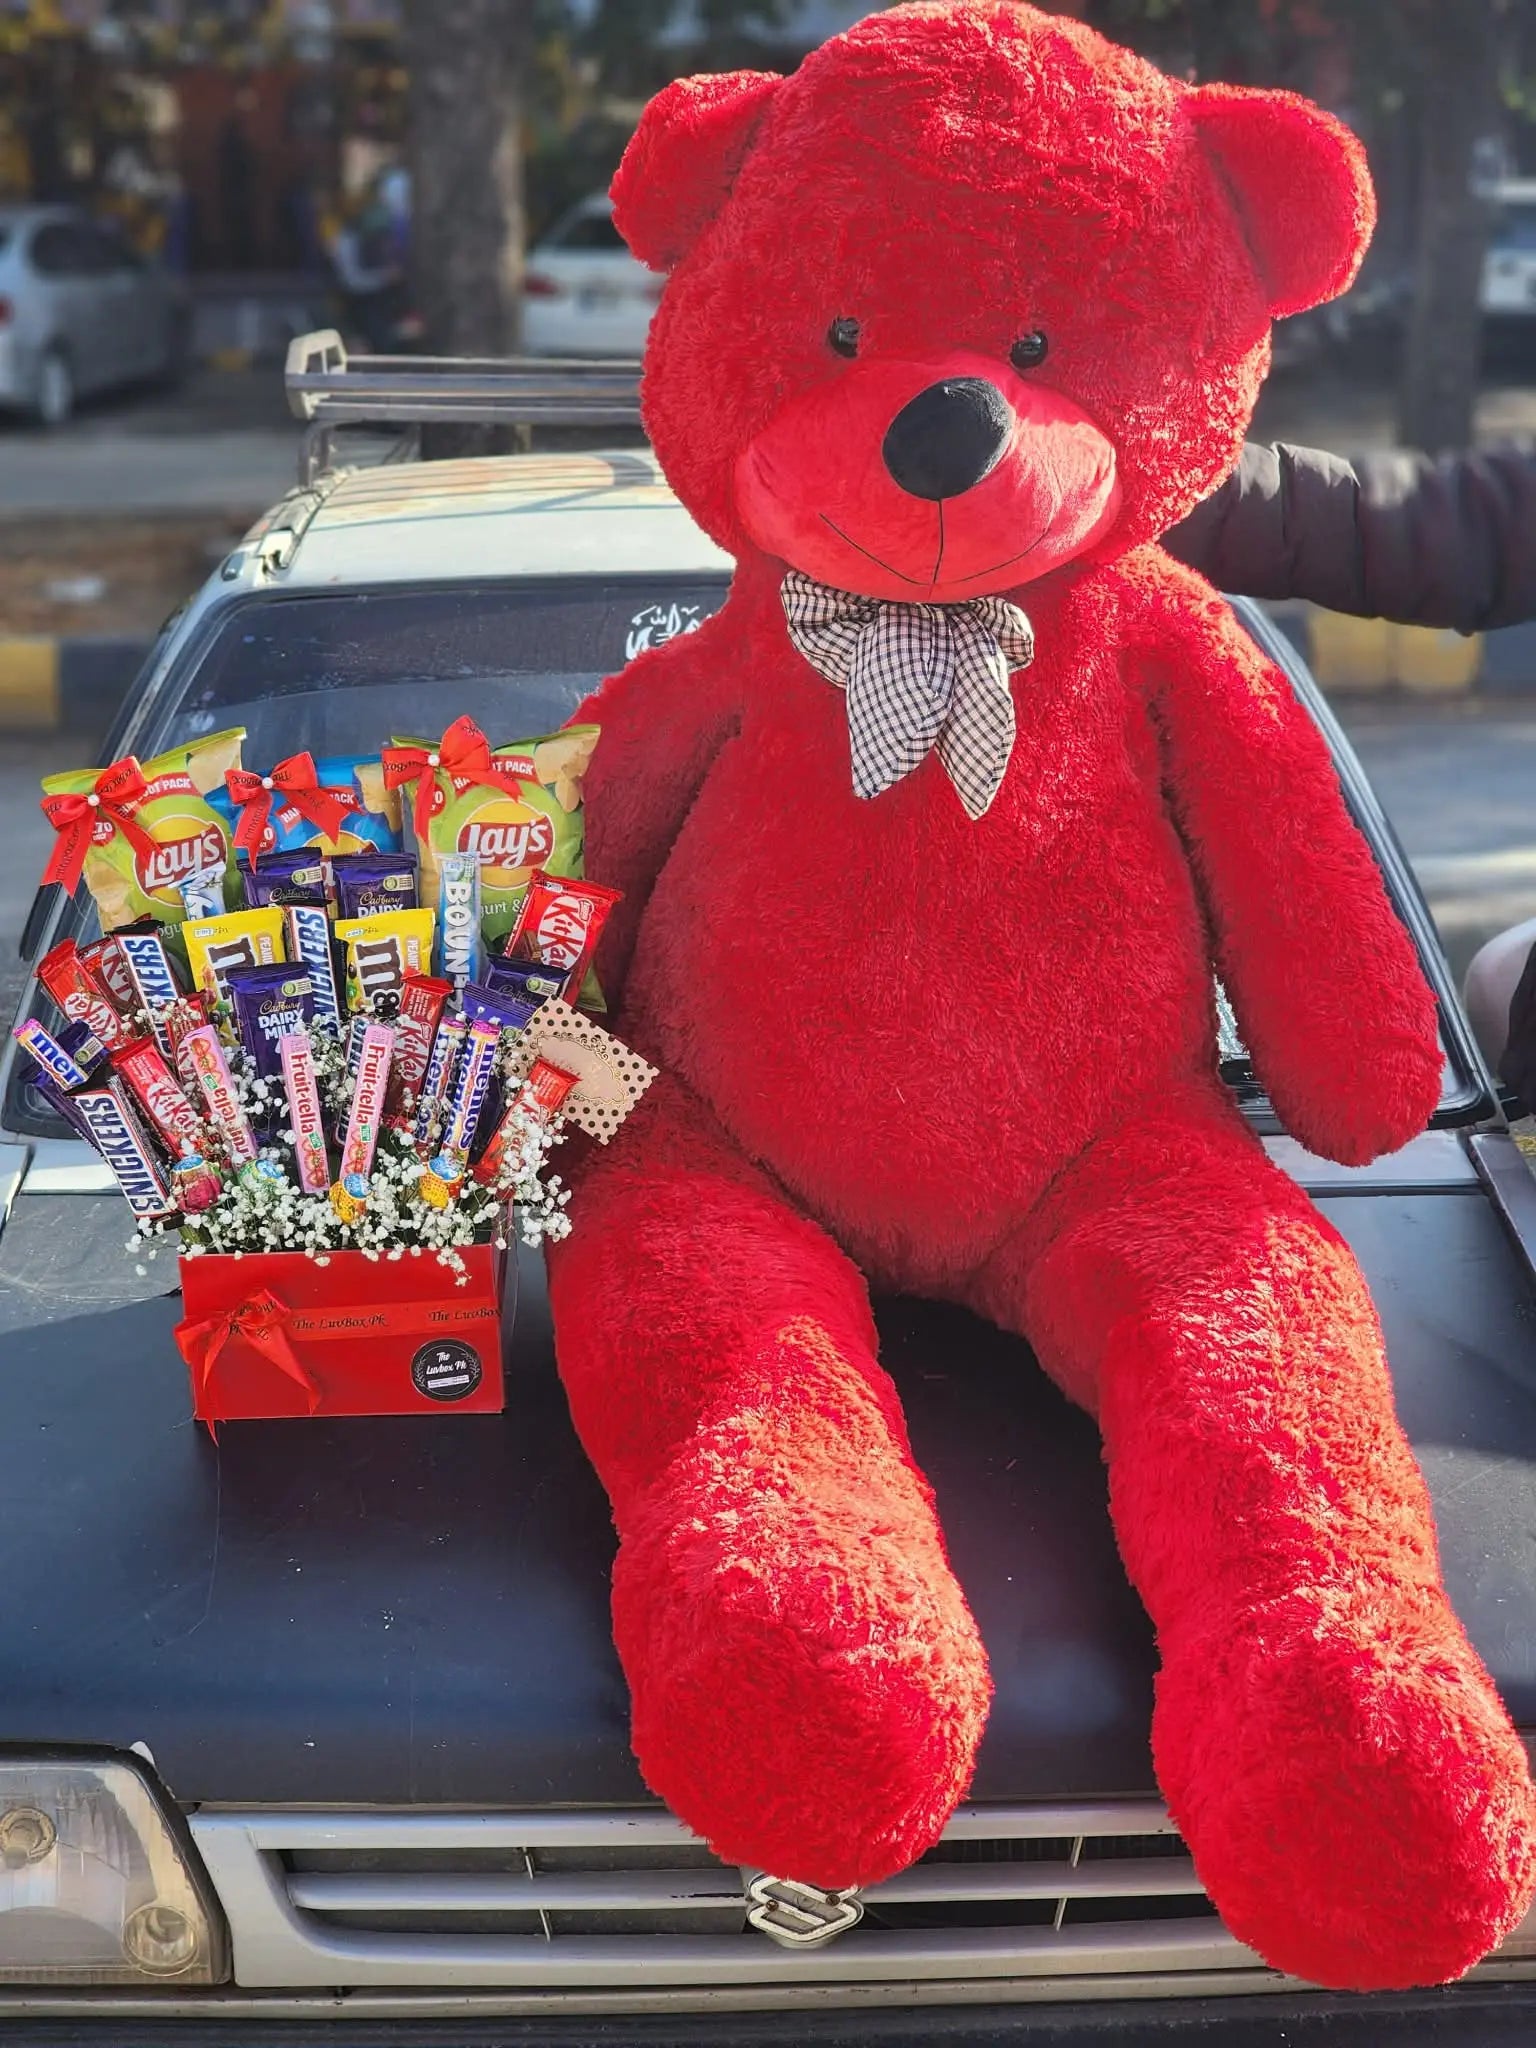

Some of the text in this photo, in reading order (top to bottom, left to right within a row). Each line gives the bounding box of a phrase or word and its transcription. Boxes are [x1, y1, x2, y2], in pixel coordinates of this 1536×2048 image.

[162, 777, 192, 791] PACK
[505, 760, 534, 775] PACK
[144, 831, 220, 888] Lay's
[467, 819, 548, 870] Lay's
[258, 936, 273, 965] PEANU
[258, 1009, 304, 1028] DAIRY
[259, 1000, 301, 1015] Cadbury
[30, 1031, 86, 1086] men
[355, 1043, 386, 1125] Fruit-tella
[290, 1052, 316, 1135] Fruit-tella
[460, 1042, 498, 1150] mentos
[82, 1098, 165, 1212] SNICKERS
[293, 1318, 315, 1330] The
[318, 1315, 368, 1330] LuvBox
